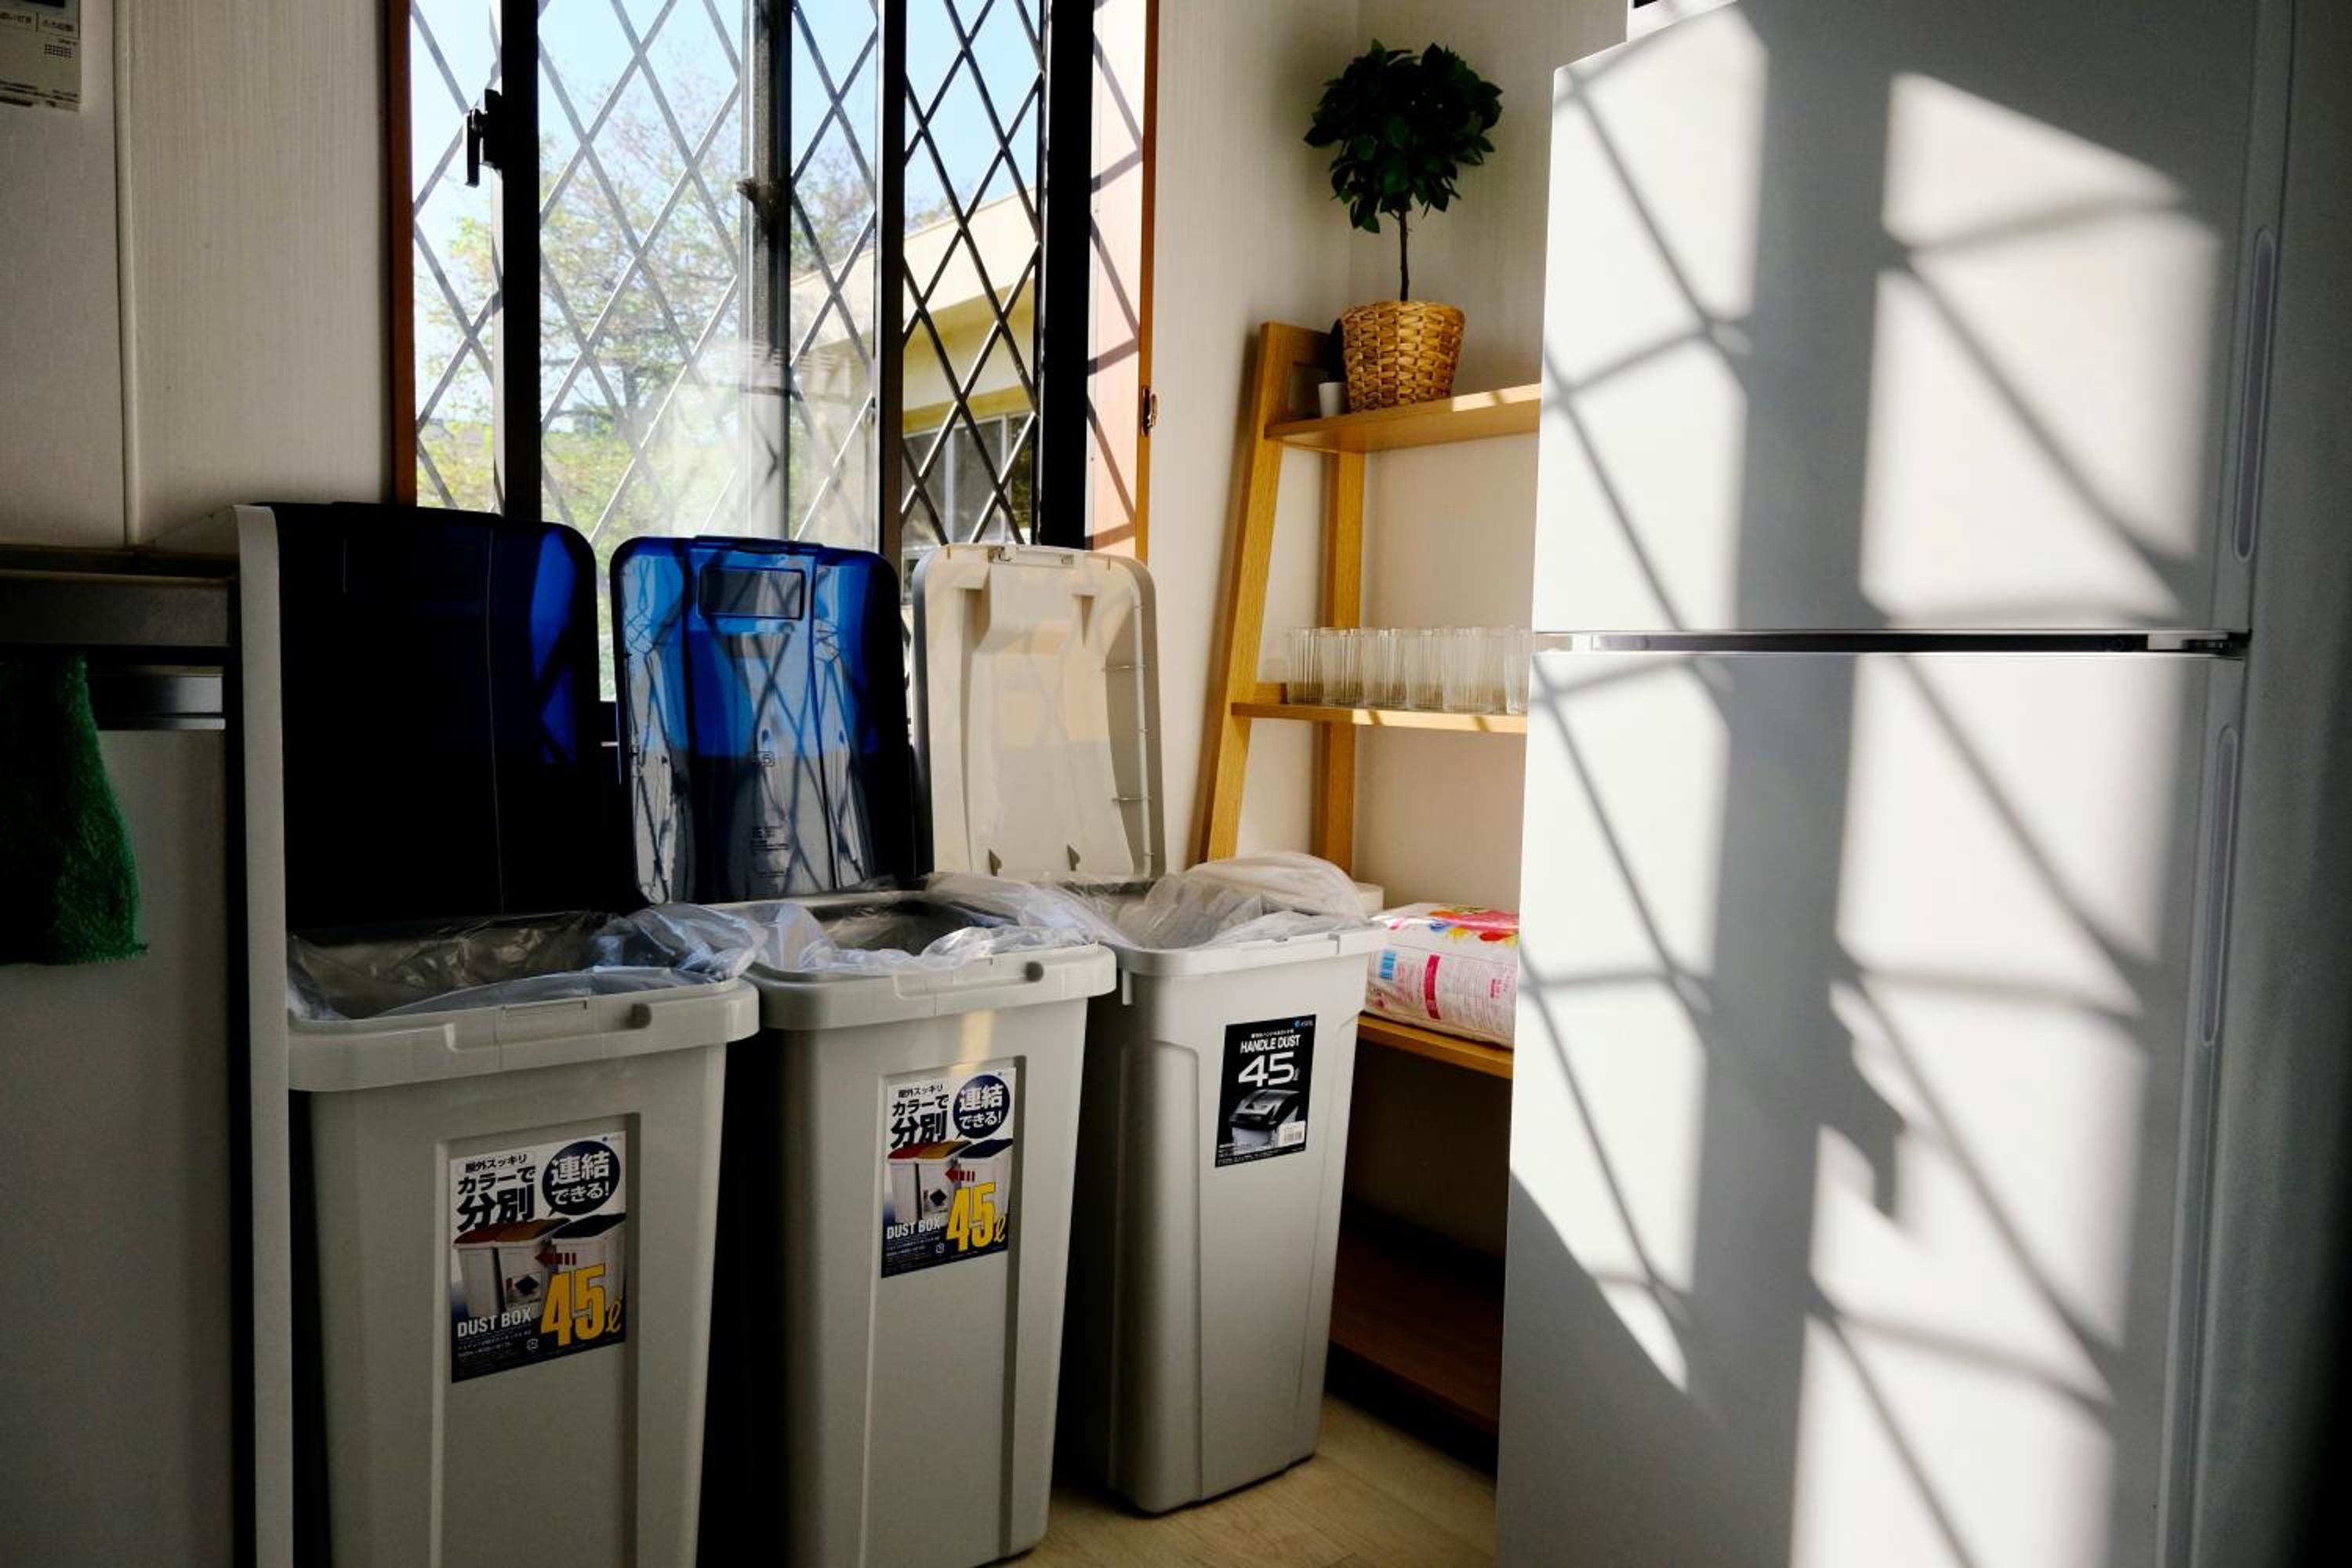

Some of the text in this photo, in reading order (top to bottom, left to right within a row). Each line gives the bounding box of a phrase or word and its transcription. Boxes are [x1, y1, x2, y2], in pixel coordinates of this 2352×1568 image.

[1240, 1034, 1301, 1054] HANDLE DUST
[892, 1094, 949, 1116] カラーで
[959, 1083, 1004, 1112] 連結
[891, 1110, 947, 1149] 分別
[960, 1110, 1002, 1130] できる!
[465, 1154, 527, 1173] 屋外スッキリ
[550, 1150, 611, 1187] 連結
[458, 1166, 535, 1194] カラーで
[553, 1182, 610, 1205] できる!
[457, 1184, 535, 1232] 分別
[887, 1217, 940, 1240] DUST BOX
[456, 1307, 532, 1338] DUST BOX
